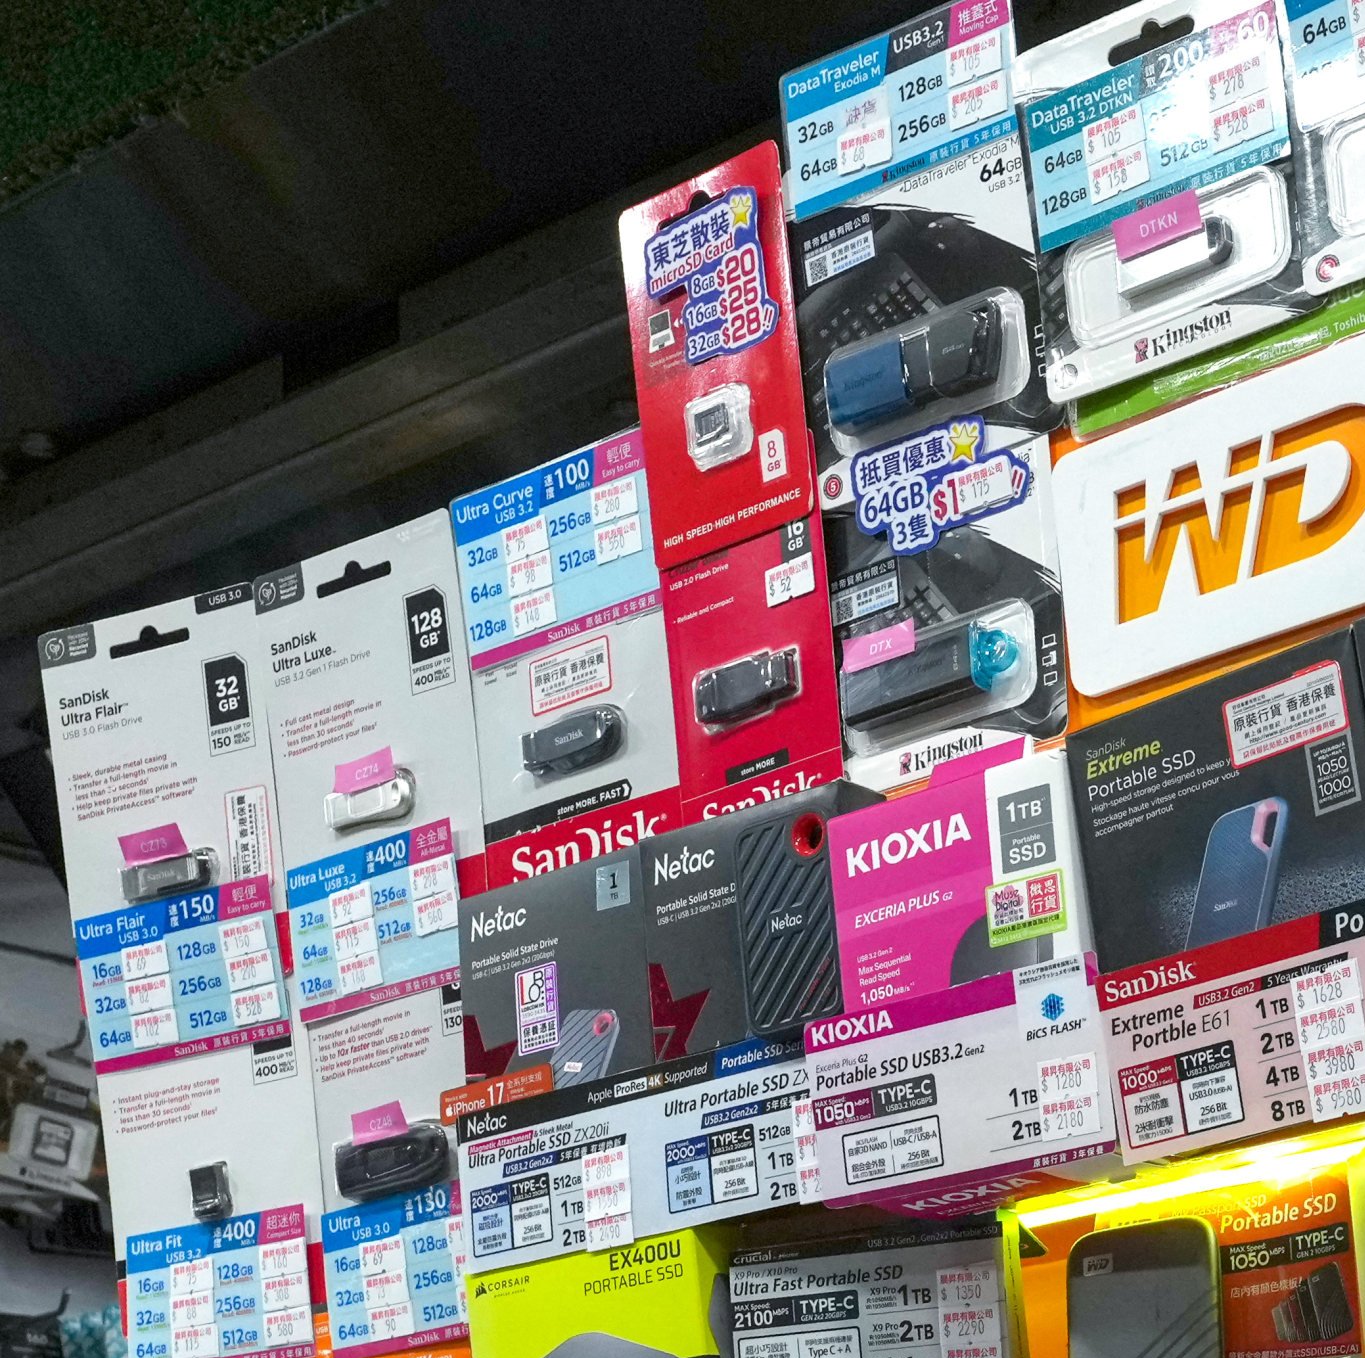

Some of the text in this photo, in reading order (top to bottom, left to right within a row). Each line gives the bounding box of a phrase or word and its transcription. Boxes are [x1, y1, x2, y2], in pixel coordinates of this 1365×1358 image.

[957, 1, 997, 26] 推蓋式
[893, 20, 945, 54] USB3.2
[788, 48, 881, 100] DataTraveler
[1159, 41, 1204, 78] 200
[898, 73, 943, 102] 128GB
[1031, 71, 1135, 127] DataTraveler
[897, 113, 947, 142] 256GB
[652, 212, 730, 270] 東芝散裝
[1139, 211, 1179, 238] DTKN
[650, 234, 734, 291] microSD Card
[690, 257, 755, 295] 8GB $20
[686, 284, 759, 326] 16GB $25
[688, 332, 720, 358] 32GB
[1150, 308, 1232, 361] Kingston
[606, 441, 631, 464] 輕便
[859, 438, 947, 488] 抵買優惠
[456, 484, 534, 526] Ultra Curve
[663, 535, 684, 549] HIGH
[738, 488, 801, 520] PERFORMANCE
[864, 484, 925, 521] 64GB
[895, 514, 929, 547] 3隻
[59, 687, 111, 712] SanDisk
[61, 701, 124, 728] Ultra Flair
[1086, 739, 1161, 779] Extreme
[1316, 756, 1348, 776] 1050
[1319, 775, 1352, 795] 1000
[415, 828, 450, 850] 全金屬
[845, 812, 972, 878] KIOXIA
[1008, 840, 1047, 864] SSD
[1012, 832, 1040, 846] Portable
[470, 903, 527, 942] Netac
[854, 890, 953, 930] EXCERIA PLUS G2
[860, 984, 893, 1006] 1,050
[1104, 959, 1196, 1003] SanDisk
[811, 1010, 893, 1049] KIOXIA
[1026, 1019, 1082, 1042] BiCS FLASH
[1111, 1001, 1185, 1038] Extreme
[1131, 1008, 1231, 1053] Portble E61
[452, 1081, 505, 1118] iPhone 17
[587, 1062, 708, 1103] Apple ProRes 4K Supported
[266, 1213, 300, 1231] 超迷你
[1221, 1192, 1337, 1234] Portable SSD
[608, 1239, 681, 1274] EX400U
[734, 1249, 772, 1266] crucial
[487, 1274, 531, 1293] CORSAIR
[583, 1262, 684, 1298] PORTABLE SSD
